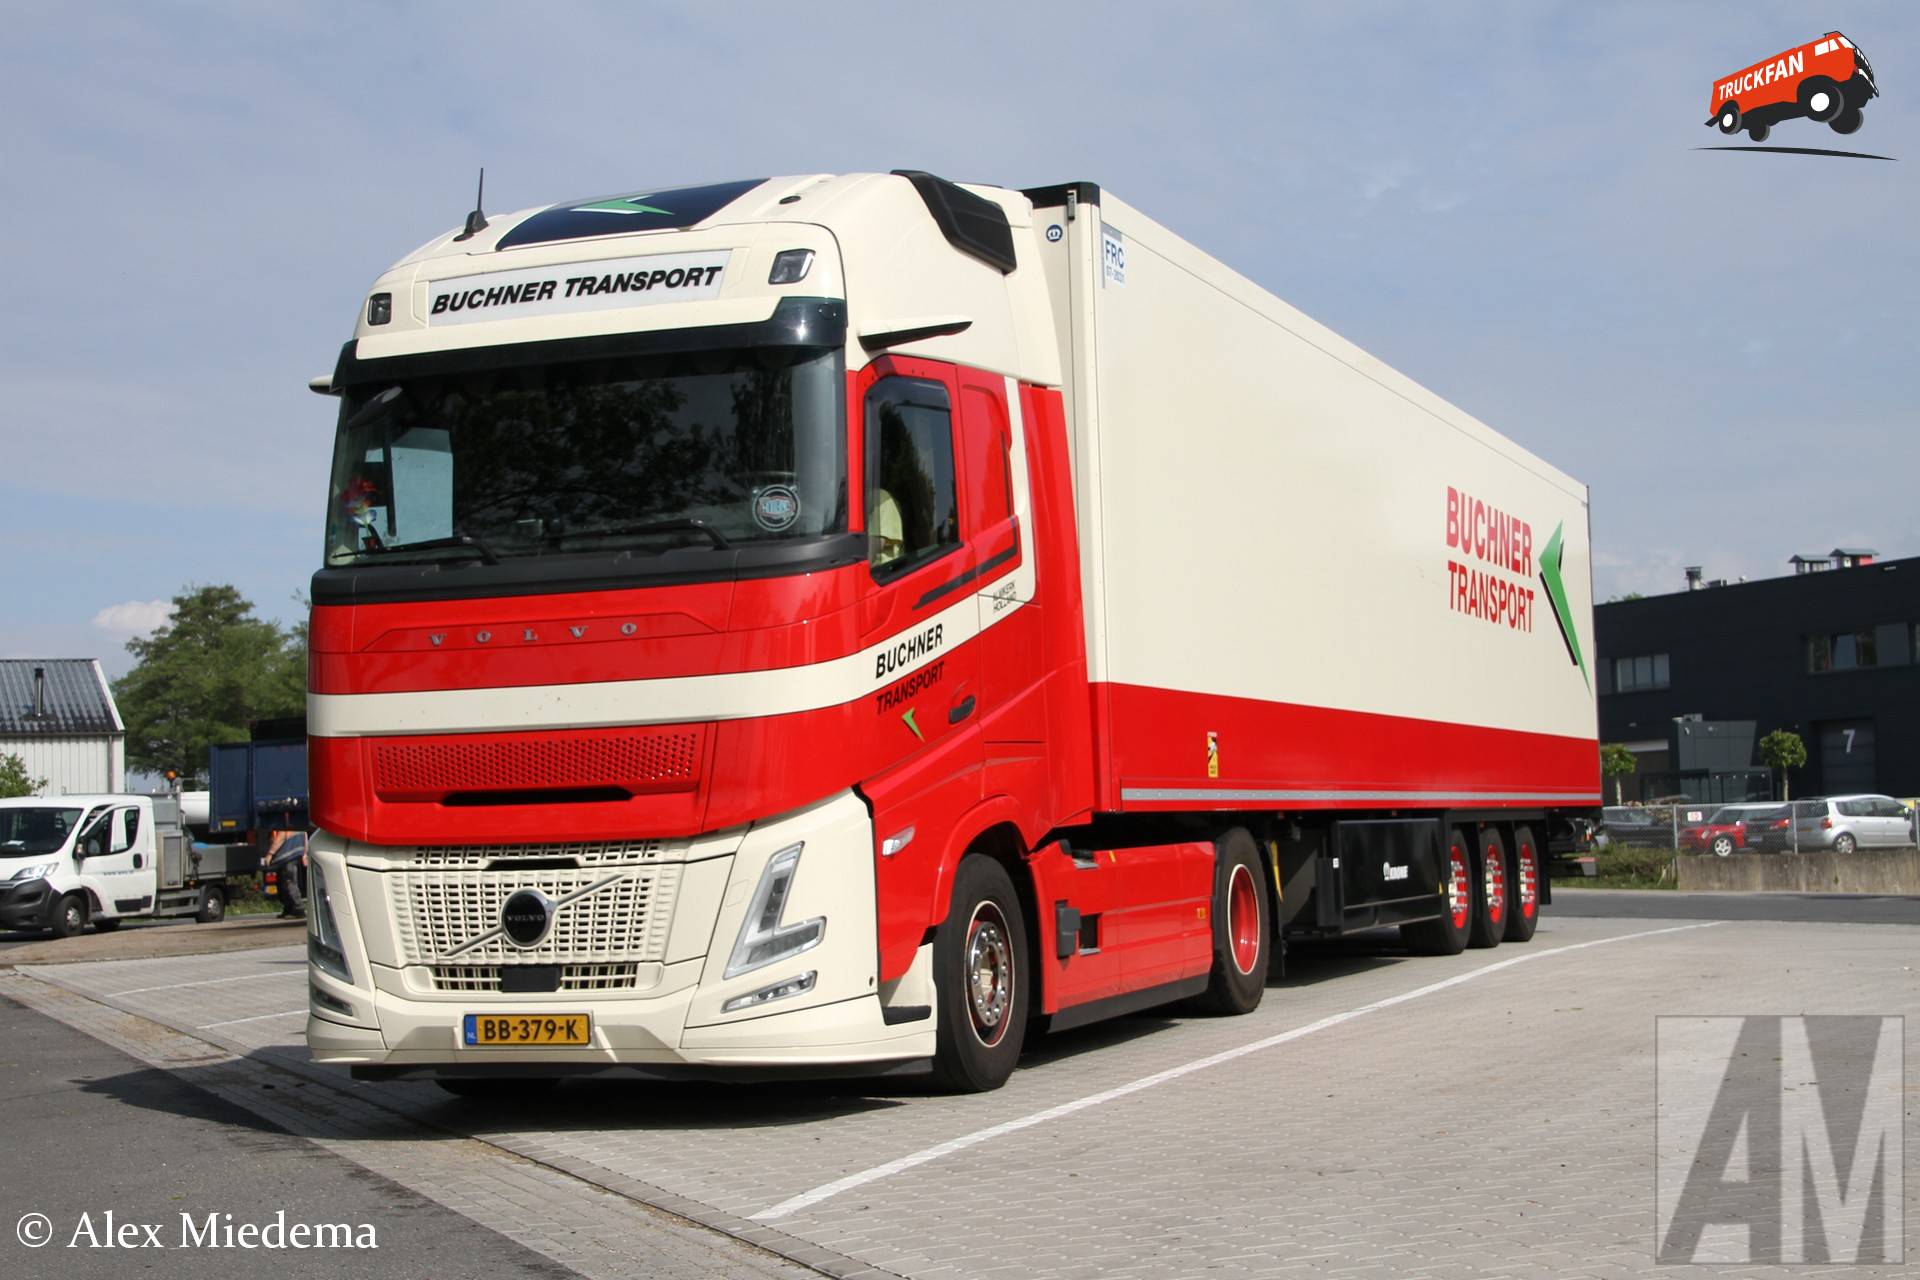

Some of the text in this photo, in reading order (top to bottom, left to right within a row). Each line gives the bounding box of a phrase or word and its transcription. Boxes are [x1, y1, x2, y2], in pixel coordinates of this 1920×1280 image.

[1105, 240, 1124, 269] FRC
[431, 266, 723, 315] BUCHNER TRANSPORT
[1446, 486, 1532, 578] BUCHNER
[1448, 560, 1534, 633] TRANSPORT
[429, 622, 637, 646] VOLVO
[876, 623, 943, 679] BUCHNER
[876, 661, 945, 715] TRANSPORT
[1842, 729, 1855, 753] 7
[506, 914, 545, 922] VOLVO
[484, 1019, 579, 1041] BB-379-K
